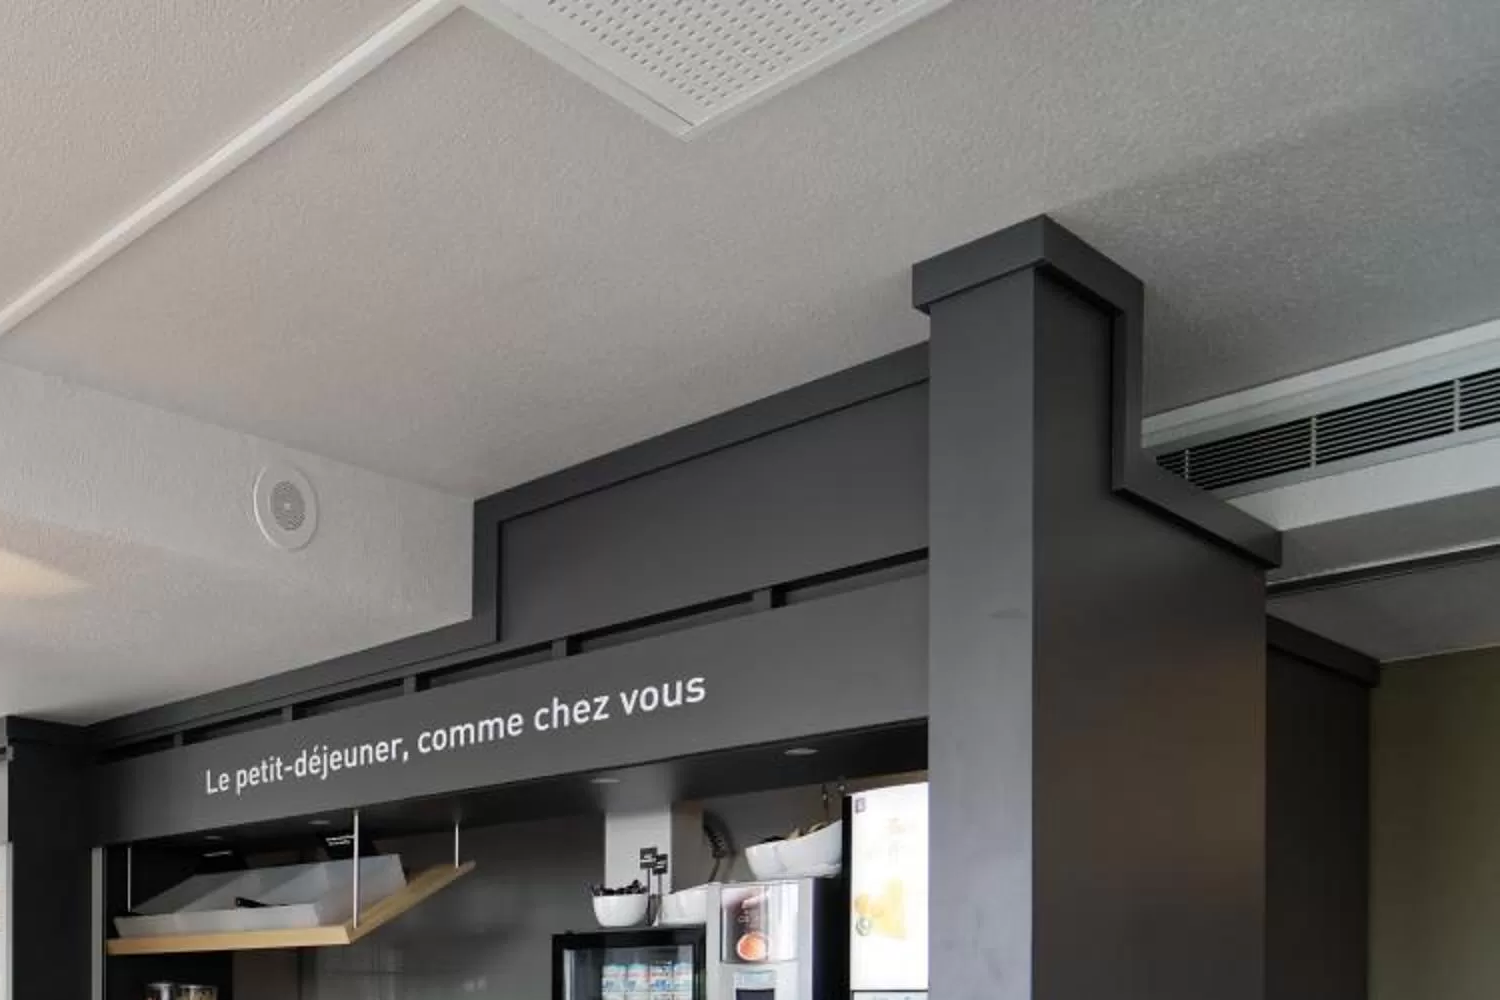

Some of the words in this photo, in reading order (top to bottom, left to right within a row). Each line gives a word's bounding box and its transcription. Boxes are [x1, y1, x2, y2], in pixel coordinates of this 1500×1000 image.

[206, 769, 230, 795] Le
[236, 736, 409, 796] petit-déjeuner,
[417, 709, 524, 754] comme
[534, 691, 609, 732] chez
[619, 675, 706, 715] vous
